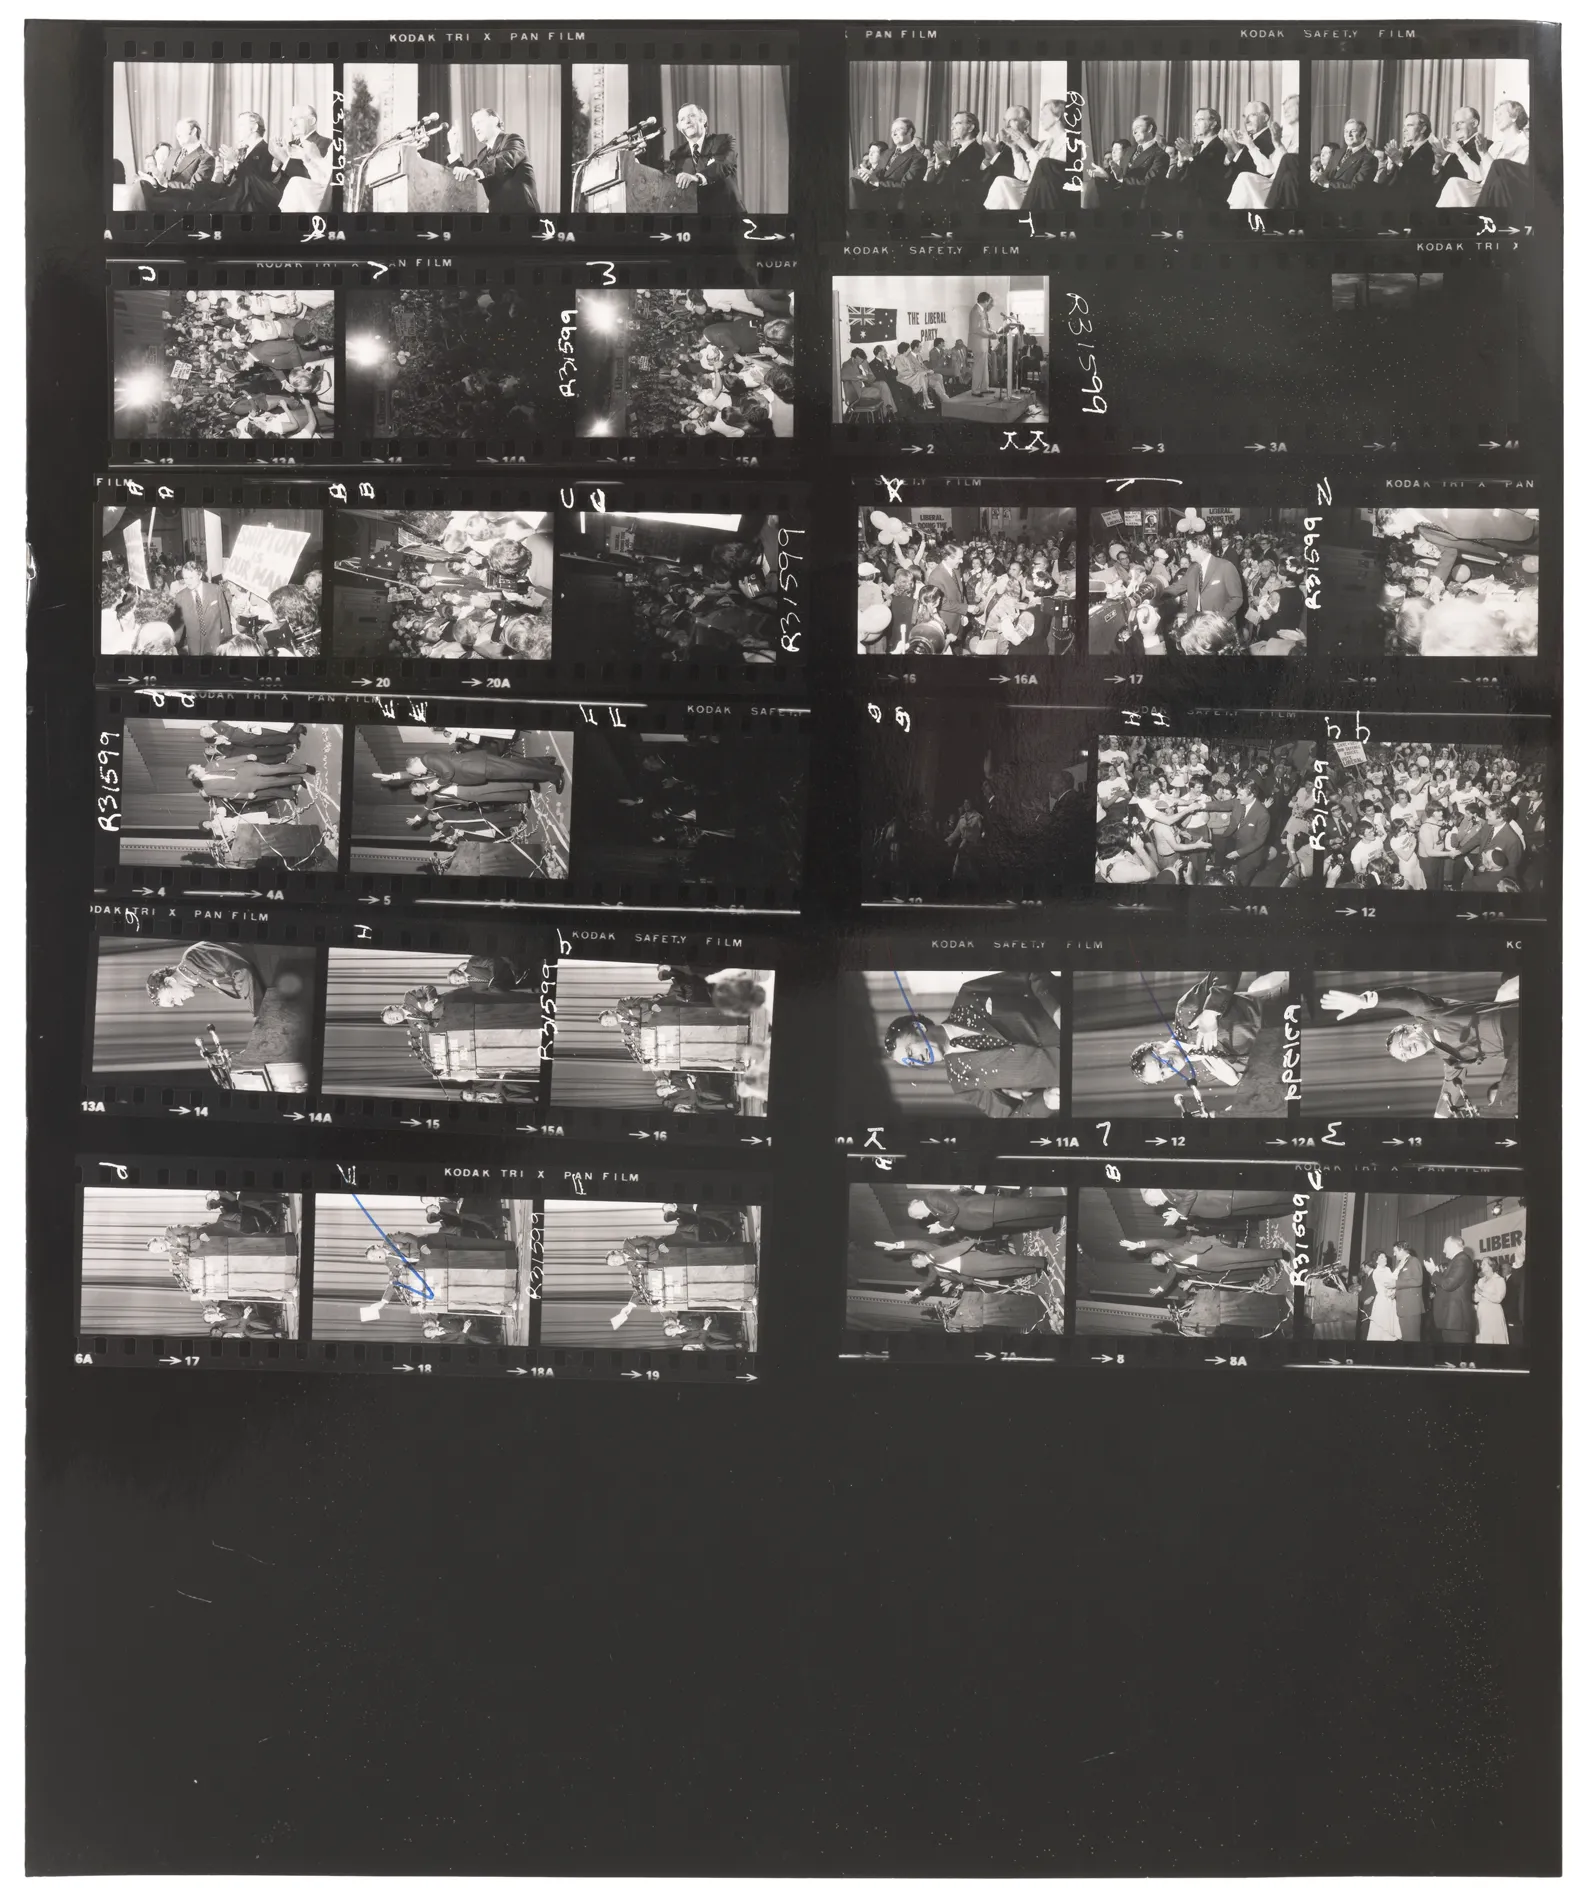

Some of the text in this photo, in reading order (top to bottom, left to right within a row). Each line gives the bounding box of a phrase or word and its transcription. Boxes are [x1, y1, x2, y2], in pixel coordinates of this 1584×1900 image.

[390, 34, 435, 42] KODAK
[549, 32, 584, 40] FILM
[901, 30, 936, 38] FILM
[1241, 30, 1284, 38] KODAK
[104, 230, 112, 239] A
[214, 231, 221, 240] 8
[328, 231, 346, 240] 8A
[443, 232, 451, 240] 9
[558, 232, 575, 242] 9A
[677, 232, 690, 242] 10
[1177, 230, 1183, 239] 6
[1404, 228, 1412, 237] 7
[1417, 243, 1463, 251] KODAK
[907, 311, 947, 325] THE LIBERAL
[920, 328, 938, 342] PARTY
[1066, 292, 1107, 415] R31599
[927, 444, 934, 453] 2
[1043, 444, 1060, 454] 2A
[1158, 443, 1164, 453] 3
[1270, 442, 1286, 452] 3A
[96, 478, 134, 487] FILM
[1386, 480, 1534, 488] KODAK PAN
[777, 528, 805, 652] R31599
[376, 678, 390, 687] 20
[487, 678, 510, 688] 20A
[1015, 675, 1037, 684] 16A
[1130, 675, 1143, 684] 17
[97, 732, 121, 832] R31599
[1309, 760, 1328, 851] R31599
[158, 887, 165, 896] 4
[266, 890, 284, 900] 4A
[384, 896, 390, 905] 5
[195, 910, 221, 918] PAN
[232, 912, 268, 921] FILM
[1362, 907, 1375, 917] 12
[573, 932, 615, 940] KODAK
[707, 938, 742, 947] FILM
[932, 940, 974, 948] KODAK
[82, 1101, 105, 1111] 13A
[195, 1107, 208, 1116] 14
[309, 1113, 331, 1122] 14A
[426, 1119, 439, 1128] 15
[542, 1126, 563, 1134] 15A
[654, 1131, 666, 1140] 16
[1056, 1137, 1079, 1147] 11A
[1171, 1137, 1185, 1146] 12
[1292, 1138, 1314, 1146] 12A
[1408, 1137, 1422, 1145] 13
[445, 1168, 489, 1177] KODAK
[564, 1172, 593, 1181] PAN
[603, 1173, 638, 1181] FILM
[1479, 1230, 1523, 1254] LIBER
[75, 1354, 93, 1364] 6A
[185, 1356, 199, 1365] 17
[1117, 1355, 1124, 1363] 8
[1230, 1356, 1247, 1366] 8A
[418, 1364, 431, 1372] 18
[646, 1371, 659, 1380] 19
